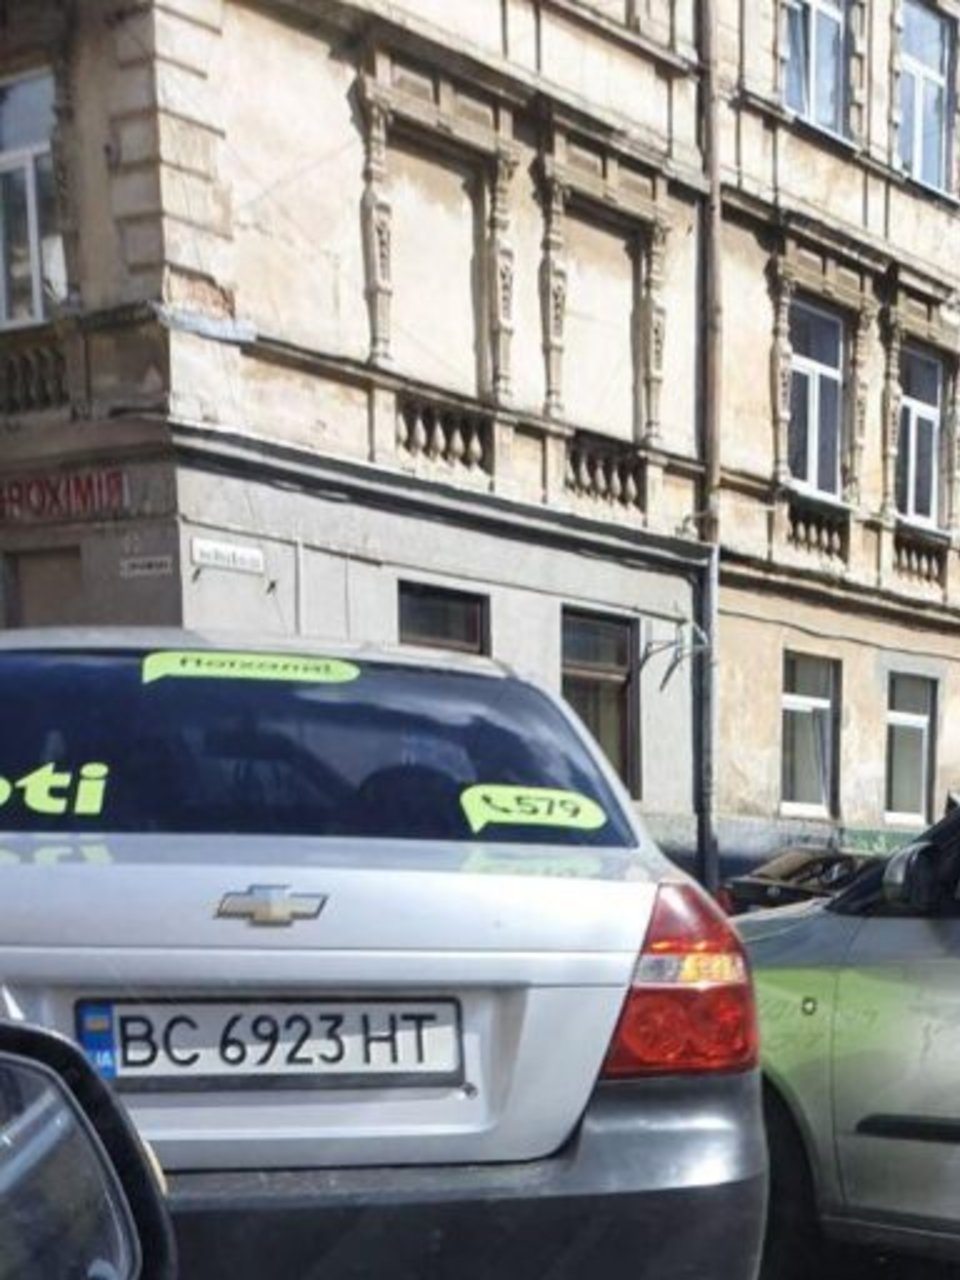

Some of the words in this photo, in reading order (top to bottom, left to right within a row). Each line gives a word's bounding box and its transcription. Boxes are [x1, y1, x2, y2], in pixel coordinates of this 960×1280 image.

[0, 762, 109, 814] ti
[514, 796, 581, 818] 579
[118, 1013, 200, 1068] BC
[218, 1013, 345, 1067] 6923
[361, 1012, 437, 1065] HT
